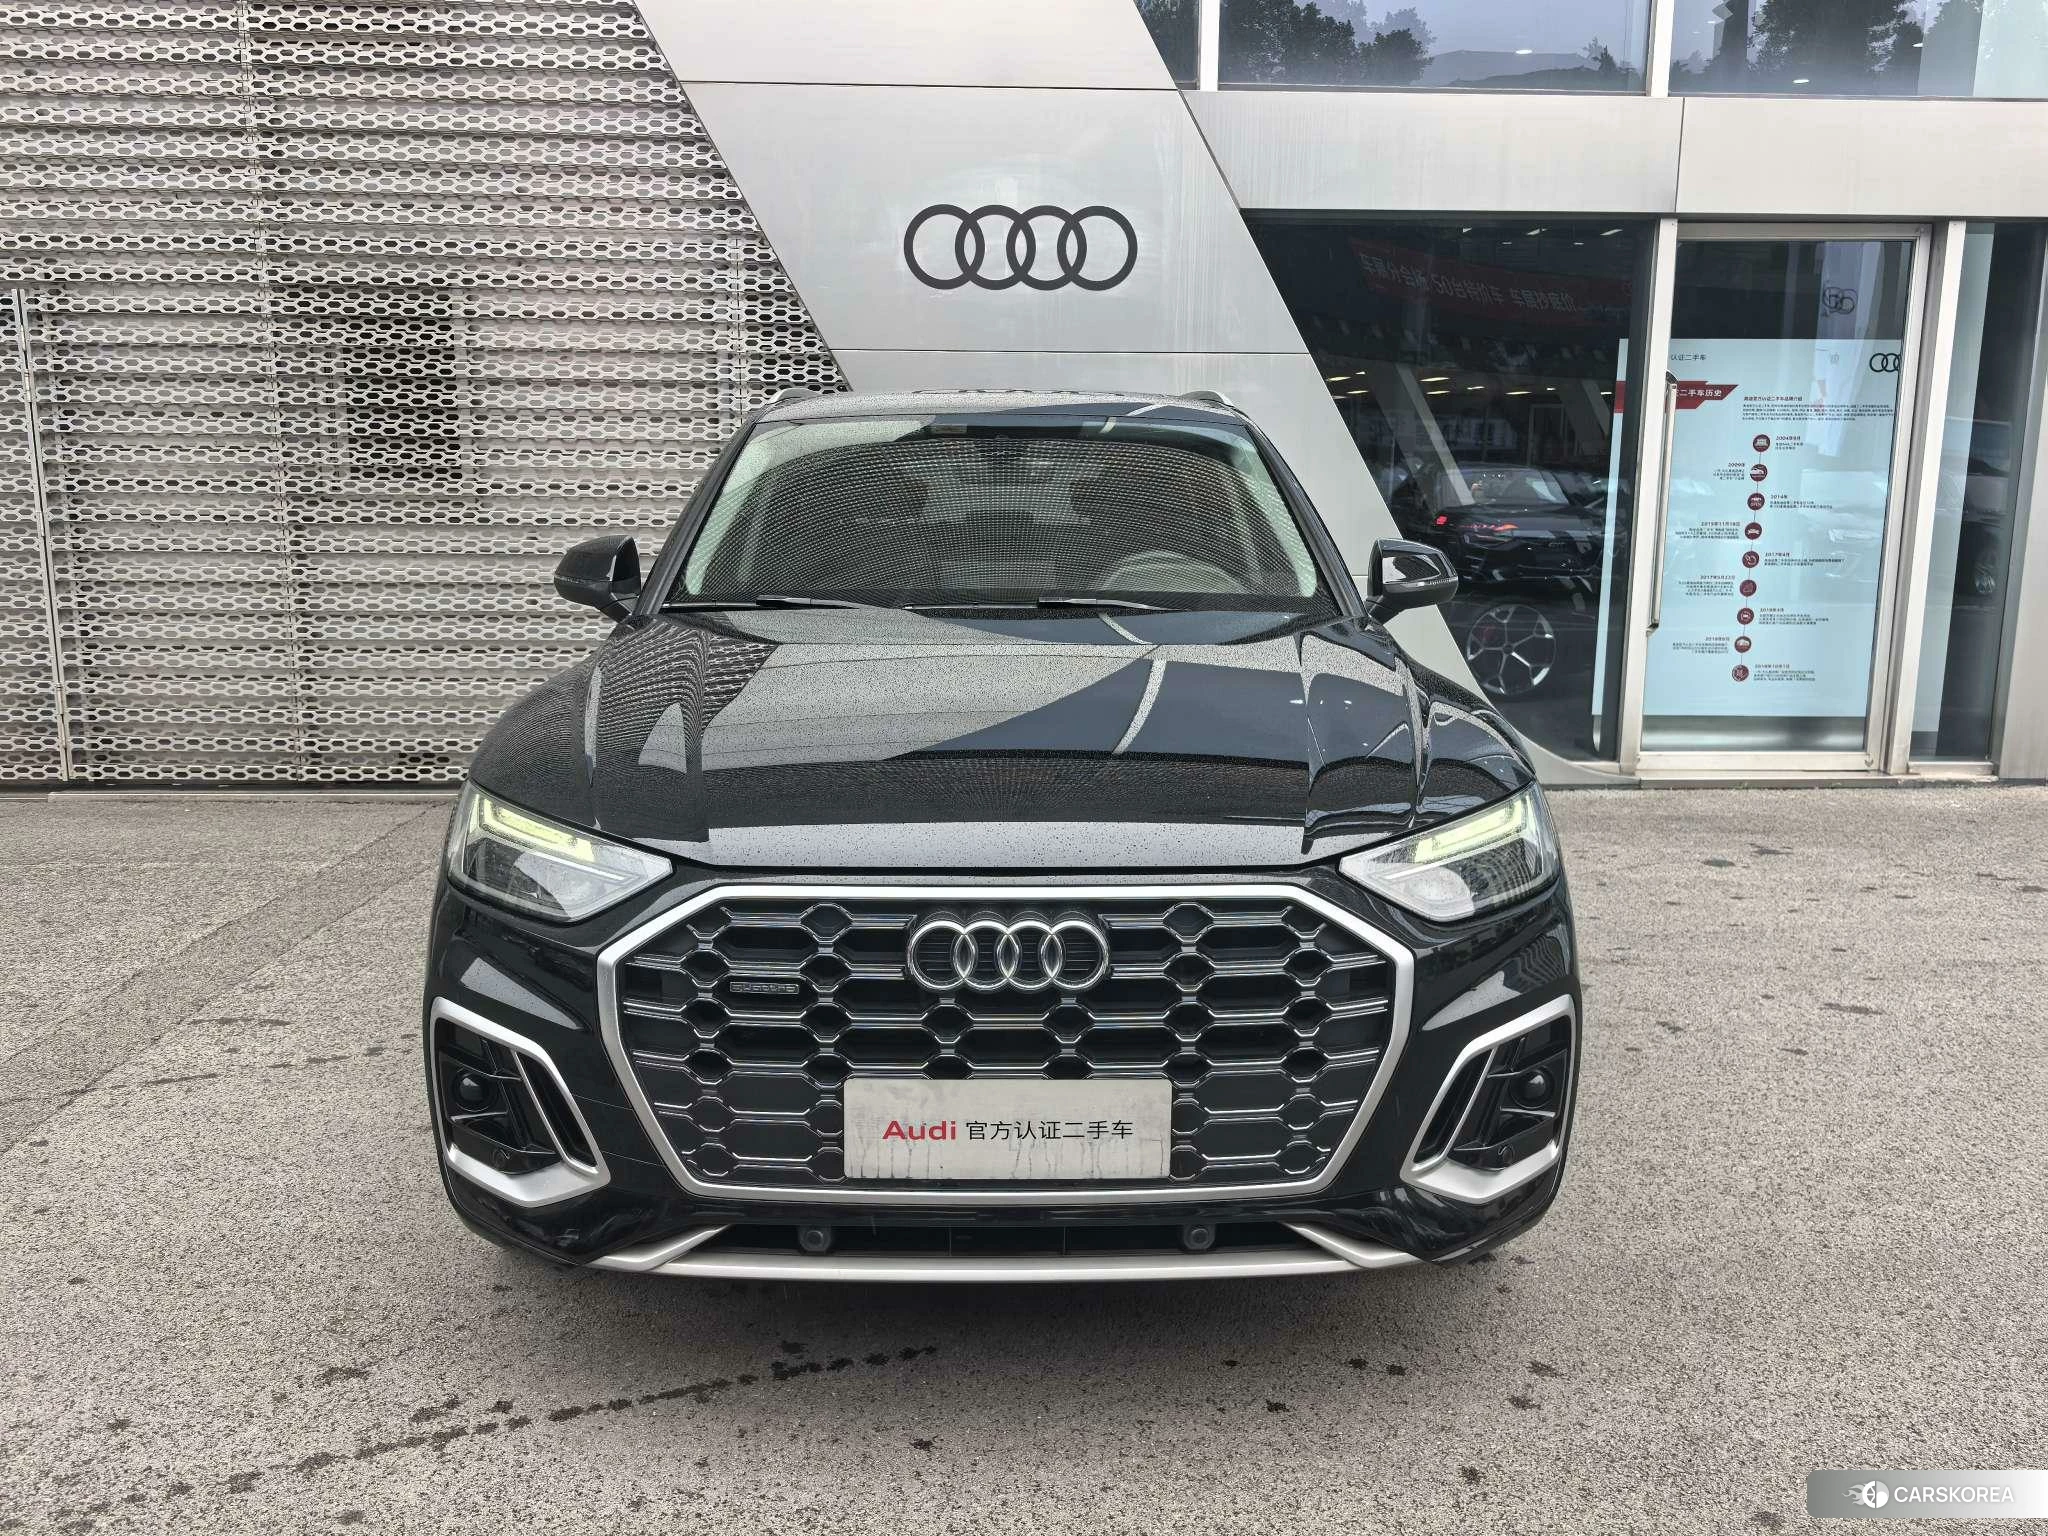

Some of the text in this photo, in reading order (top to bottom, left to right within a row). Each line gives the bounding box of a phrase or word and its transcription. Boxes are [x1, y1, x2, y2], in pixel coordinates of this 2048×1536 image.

[883, 1119, 1134, 1141] Audi 官方认证二手车
